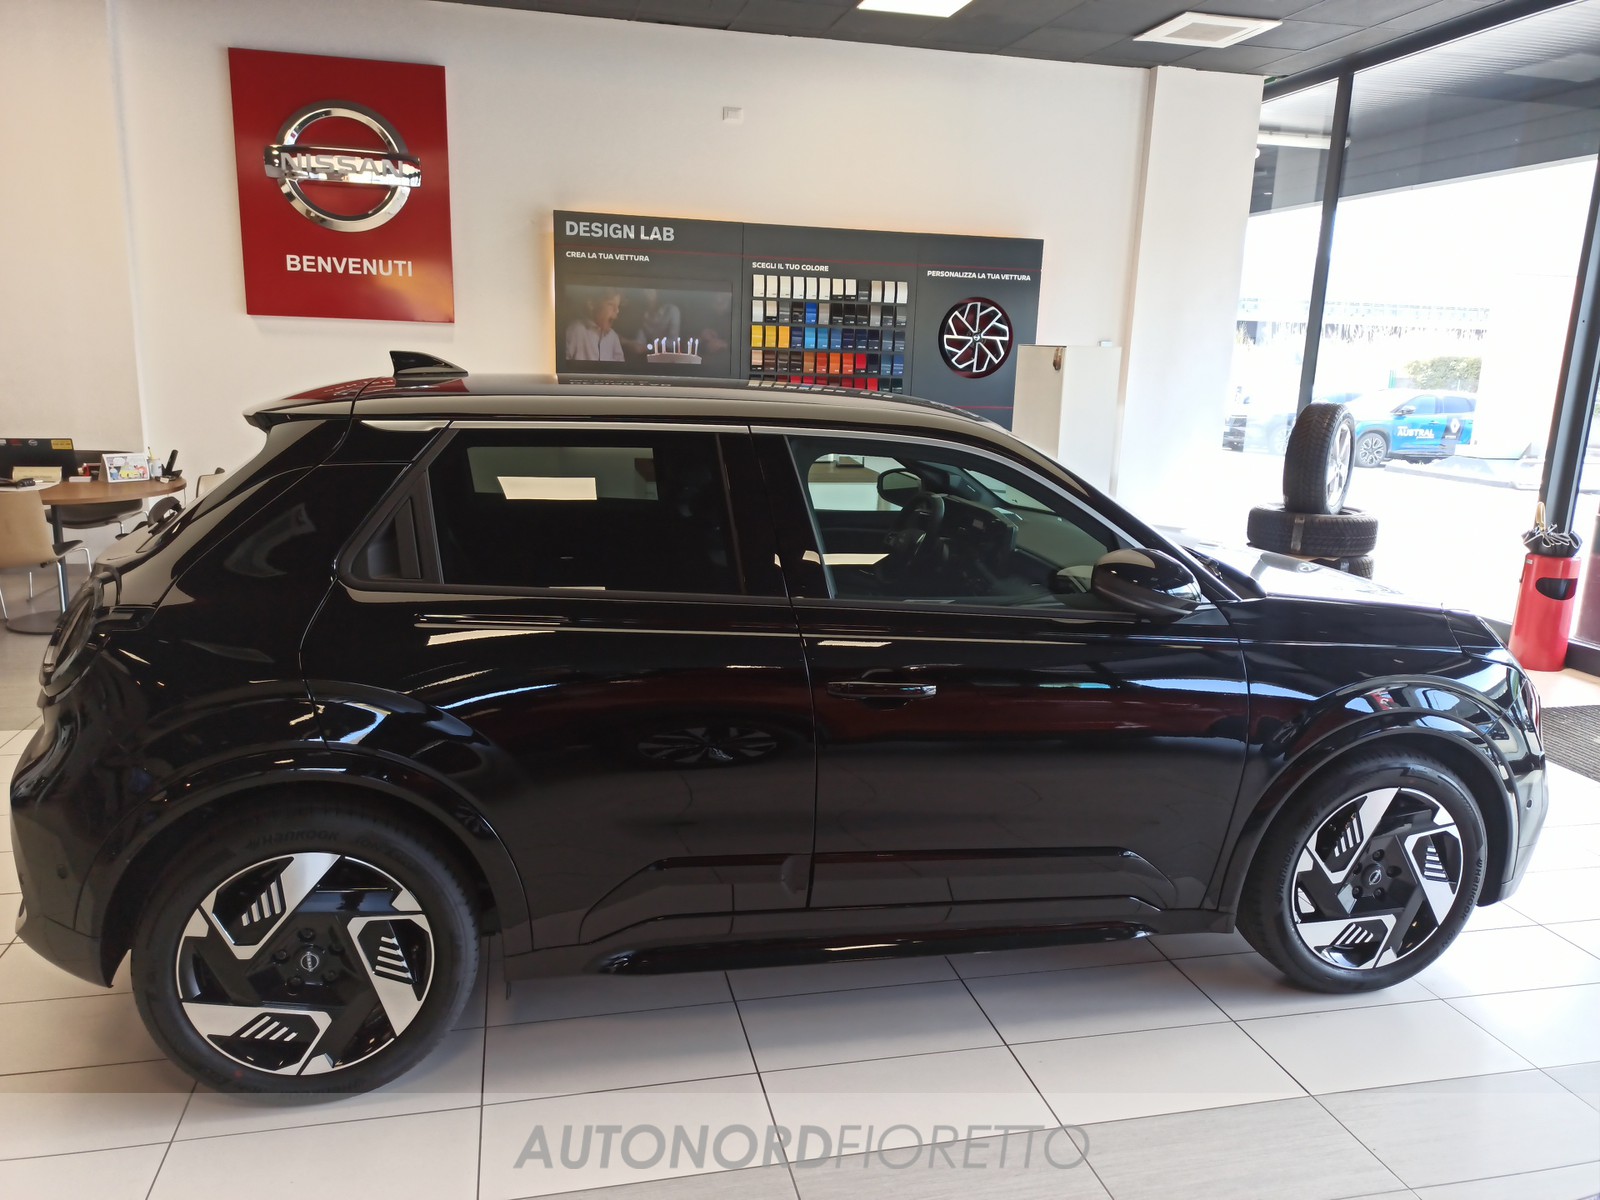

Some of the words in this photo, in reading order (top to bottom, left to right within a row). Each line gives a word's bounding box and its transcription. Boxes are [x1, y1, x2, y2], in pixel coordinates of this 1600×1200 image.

[280, 152, 403, 178] NISSAN
[565, 220, 635, 239] DESIGN
[640, 225, 675, 241] LAB
[565, 250, 586, 259] CREA
[598, 252, 614, 260] TUA
[614, 253, 650, 262] VETTURA
[286, 254, 413, 277] BENVENUTI
[752, 261, 777, 269] SCEGLI
[801, 264, 829, 272] COLORE
[927, 270, 977, 279] PERSONALIZZA
[1397, 428, 1434, 437] AUSTRAL
